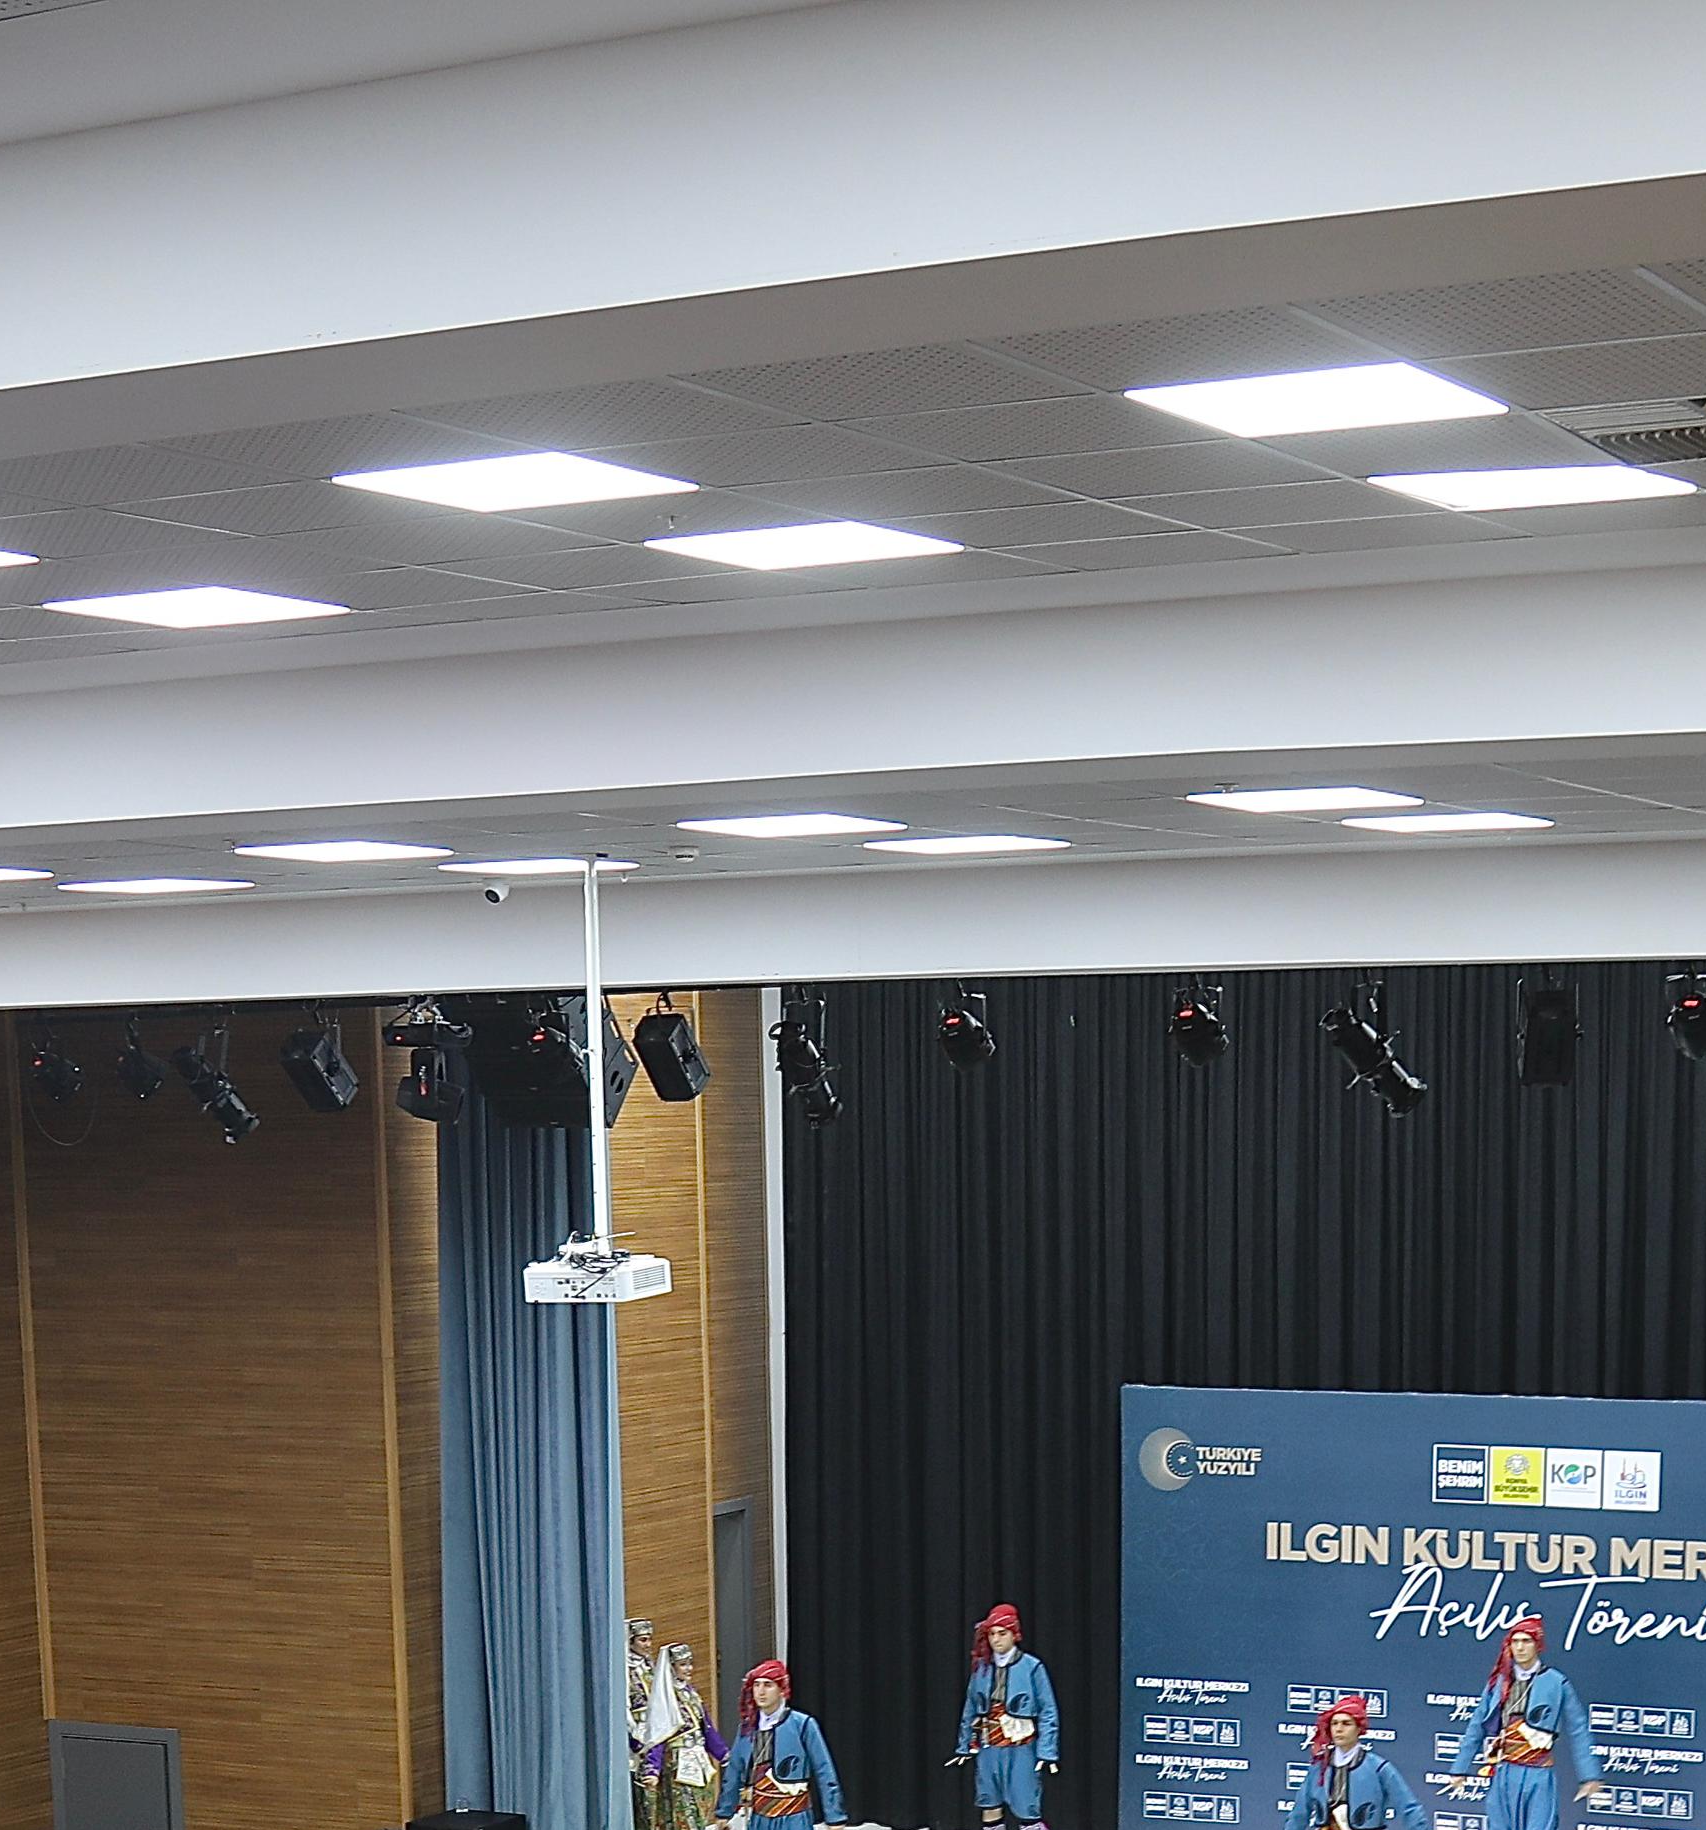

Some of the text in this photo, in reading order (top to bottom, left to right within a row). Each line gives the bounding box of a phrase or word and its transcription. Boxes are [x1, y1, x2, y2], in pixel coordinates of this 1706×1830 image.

[1551, 1463, 1597, 1485] KOP
[1614, 1489, 1648, 1500] ILGIN
[1266, 1521, 1390, 1566] ILGIN
